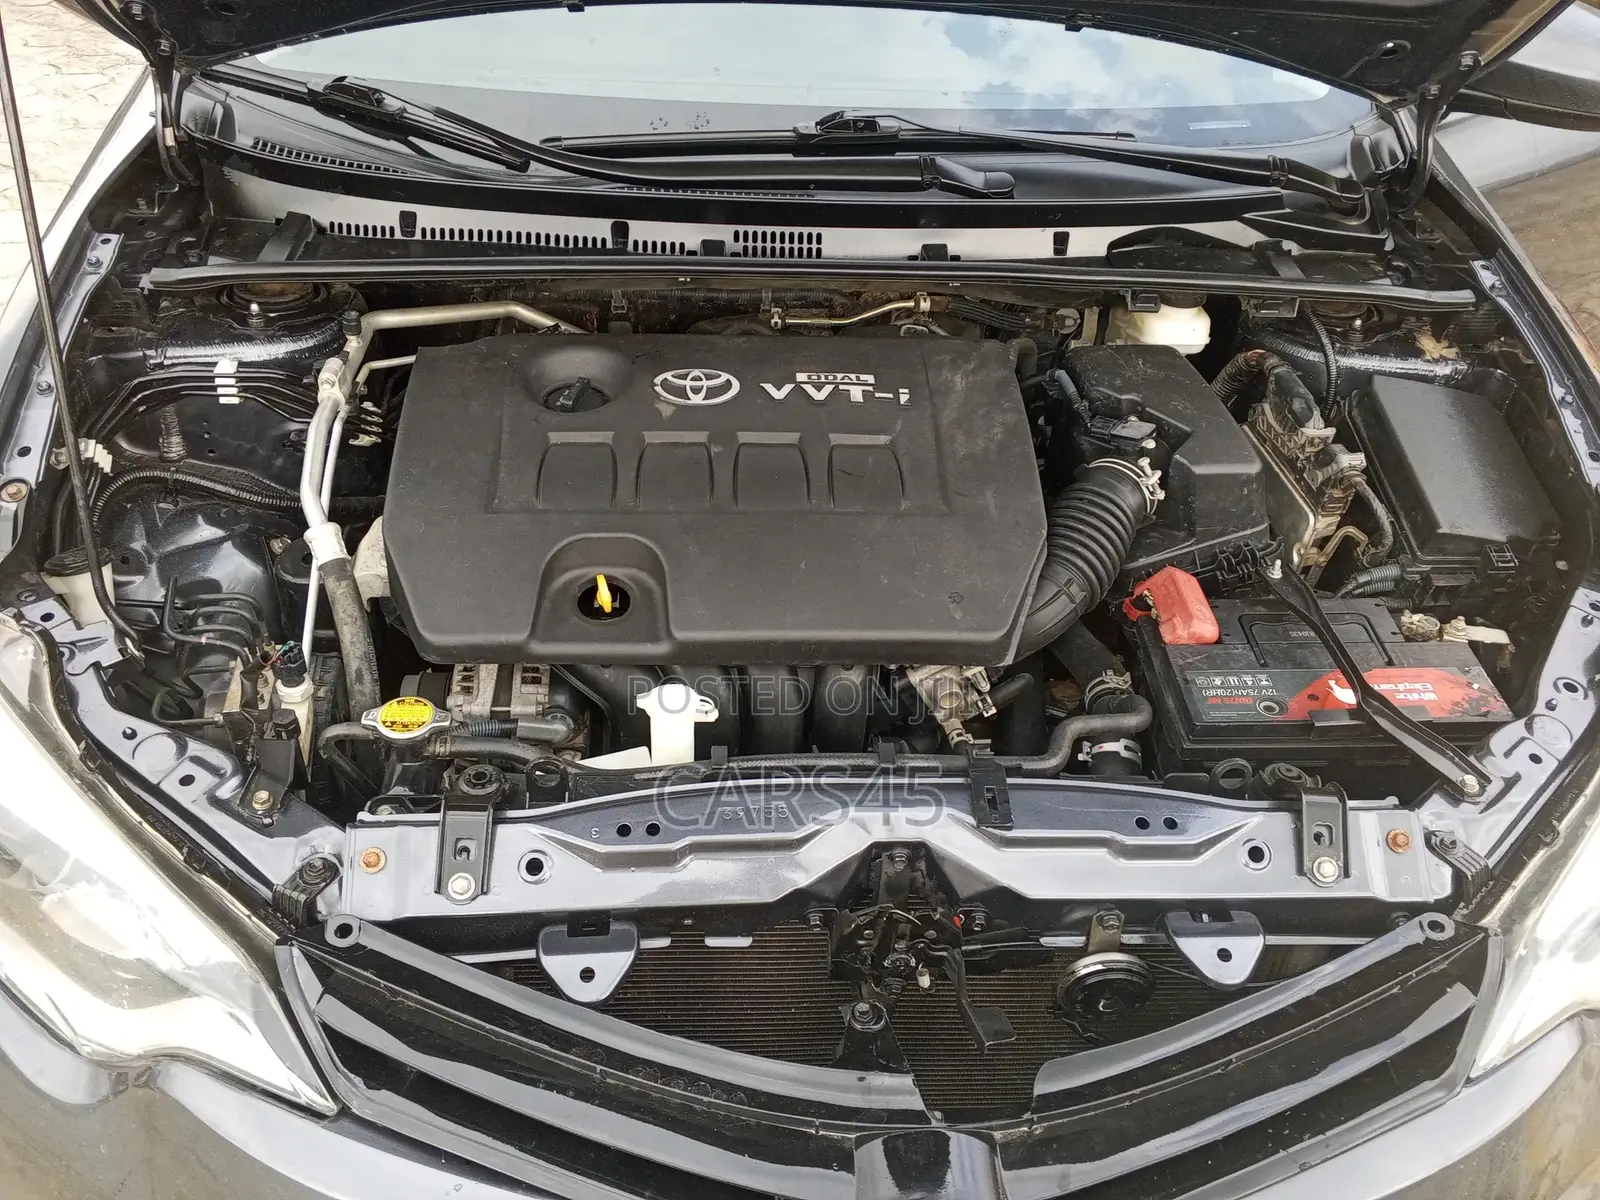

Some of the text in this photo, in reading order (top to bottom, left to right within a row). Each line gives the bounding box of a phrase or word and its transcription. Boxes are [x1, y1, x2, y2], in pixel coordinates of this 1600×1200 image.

[760, 383, 912, 406] VVT-i
[1202, 688, 1278, 696] 12V 75Ah(20HR)
[1393, 692, 1440, 701] White
